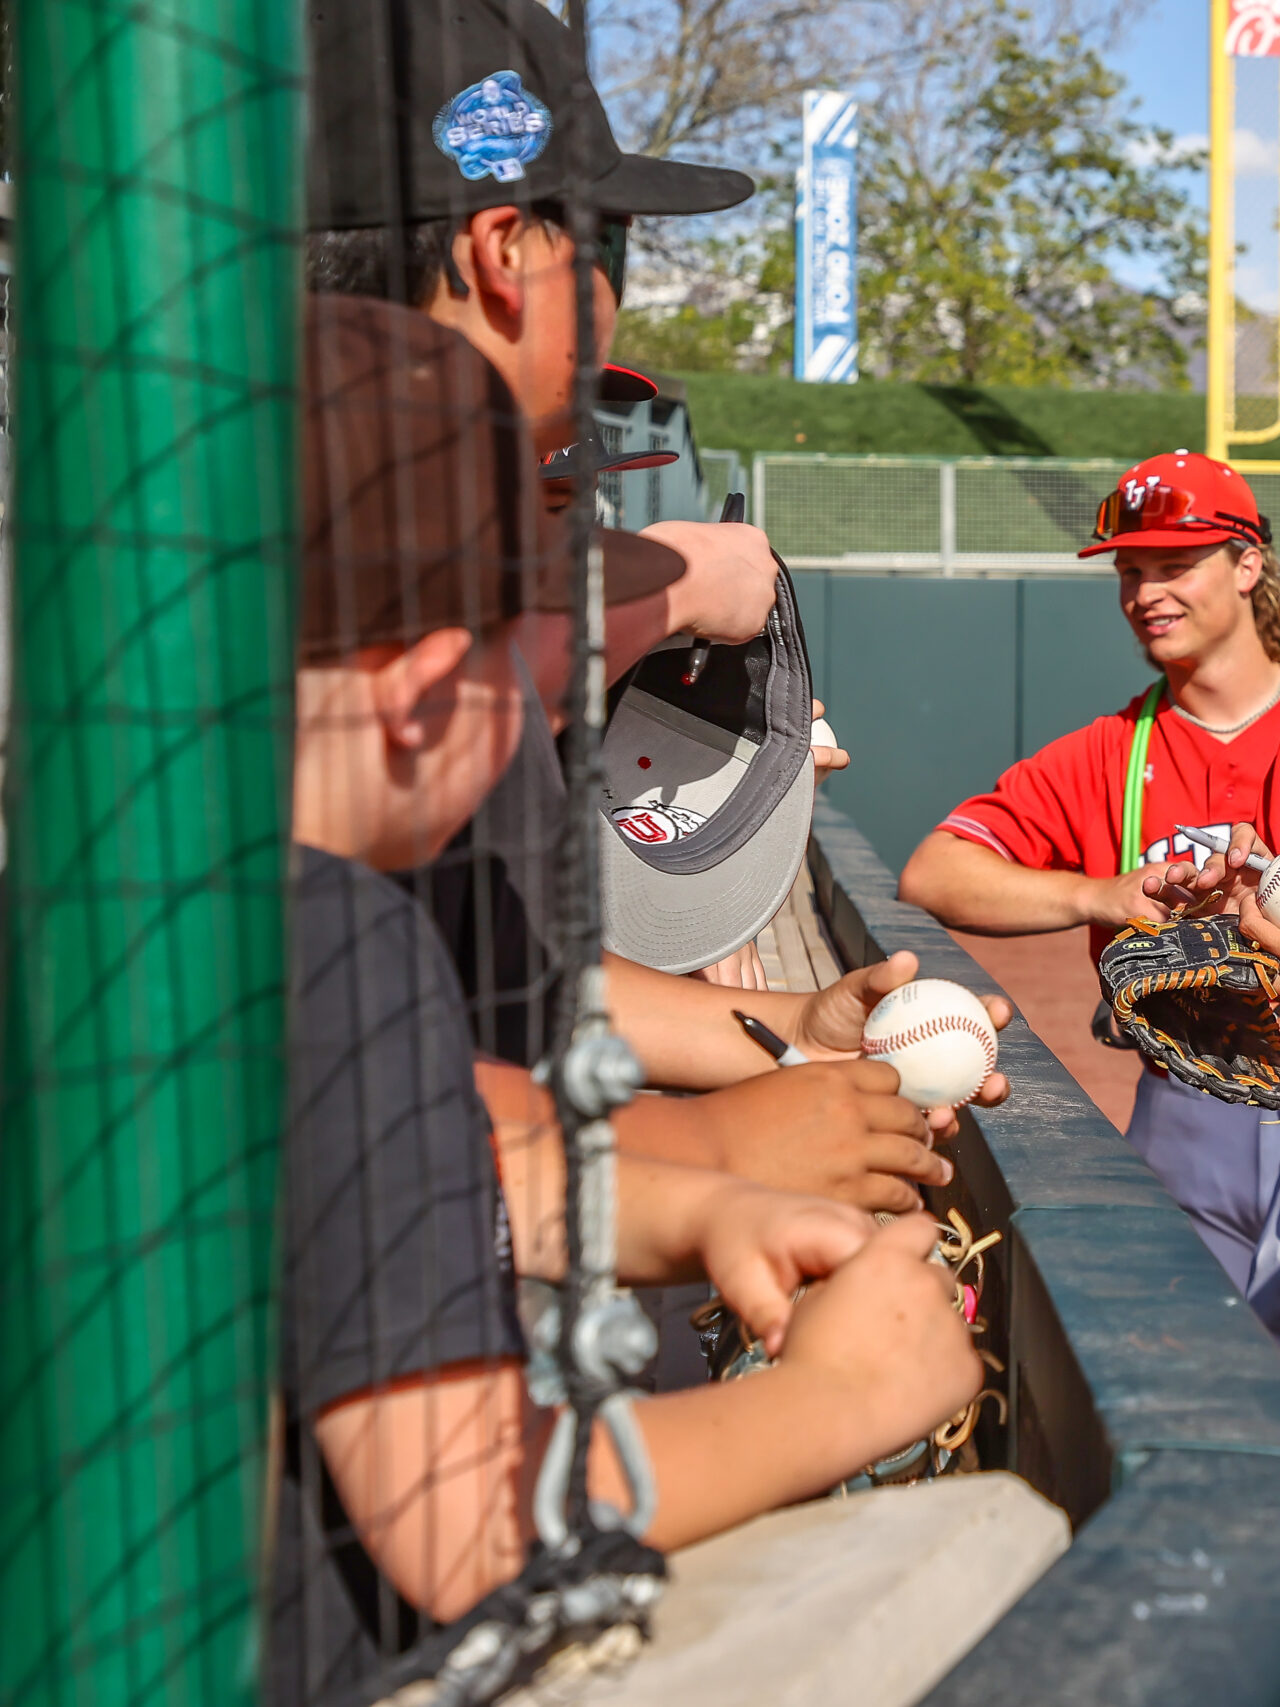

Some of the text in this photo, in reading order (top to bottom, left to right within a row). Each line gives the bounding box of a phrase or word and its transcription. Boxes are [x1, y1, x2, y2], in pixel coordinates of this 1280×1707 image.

[447, 112, 545, 148] SERIES
[826, 176, 850, 323] FOOD ZONE
[616, 812, 667, 843] U
